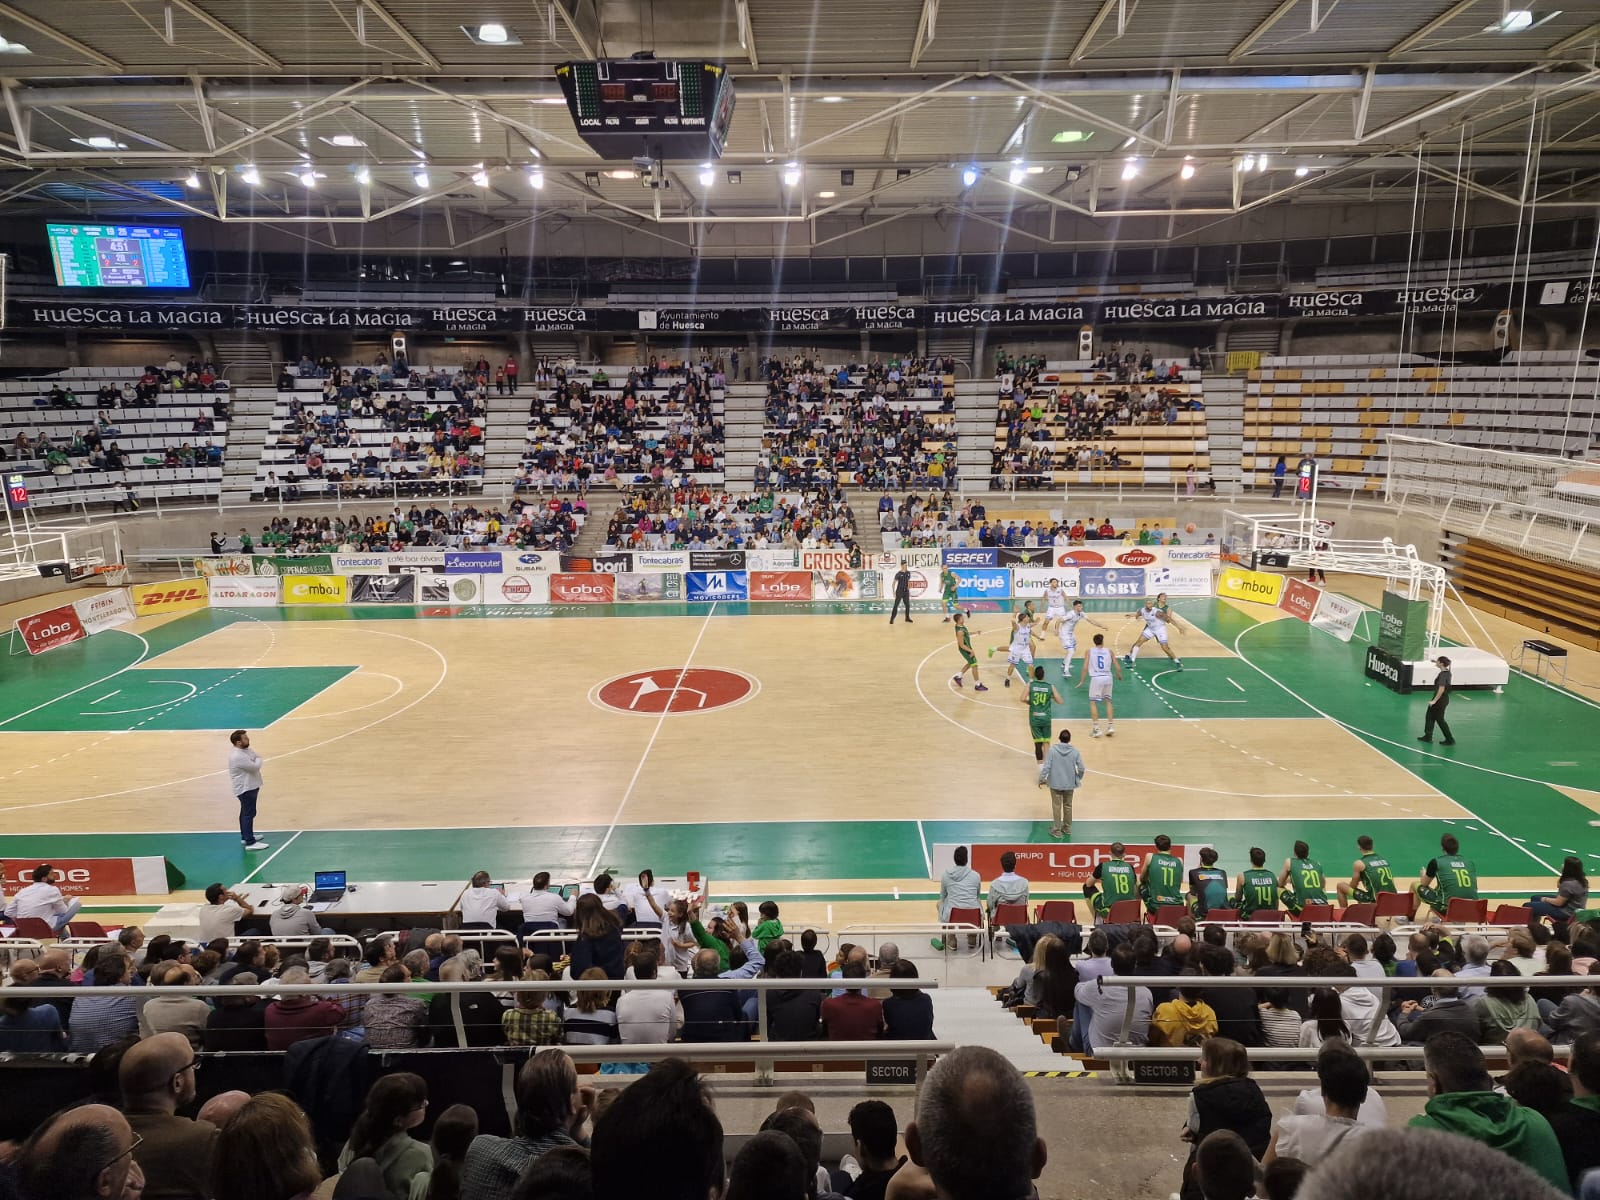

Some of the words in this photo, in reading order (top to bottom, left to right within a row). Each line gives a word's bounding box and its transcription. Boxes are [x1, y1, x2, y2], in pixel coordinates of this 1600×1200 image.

[580, 118, 602, 126] LOCAL
[659, 310, 720, 322] Ayuntamiento
[659, 322, 670, 330] de
[672, 322, 704, 330] Huesca
[1300, 478, 1310, 491] 12
[12, 488, 26, 502] 12
[459, 560, 501, 569] ecomputer
[804, 553, 875, 570] CROSSIT
[946, 553, 992, 563] SERFEY
[1122, 554, 1152, 563] Ferrer
[292, 583, 340, 596] embou
[562, 583, 603, 594] Lobe
[761, 583, 800, 592] Lobe
[1016, 578, 1076, 589] doméica
[1085, 583, 1139, 594] GASBY
[1227, 577, 1273, 594] embou
[143, 589, 202, 606] DHL
[1290, 593, 1311, 610] Lobe
[1381, 612, 1403, 626] Lobe
[32, 622, 70, 641] Lobe
[1097, 656, 1105, 669] 6
[1368, 652, 1398, 682] Huesca
[1033, 693, 1047, 706] 34
[1014, 852, 1043, 860] GRUPO
[1049, 849, 1140, 869] Lobe
[1161, 867, 1174, 886] 11
[1301, 870, 1321, 888] 20
[1377, 867, 1393, 886] 24
[1452, 869, 1471, 888] 16
[1112, 874, 1129, 894] 18
[1254, 886, 1271, 905] 14
[872, 1066, 909, 1077] SECTOR
[1140, 1066, 1177, 1078] SECTOR
[1184, 1066, 1190, 1078] 3
